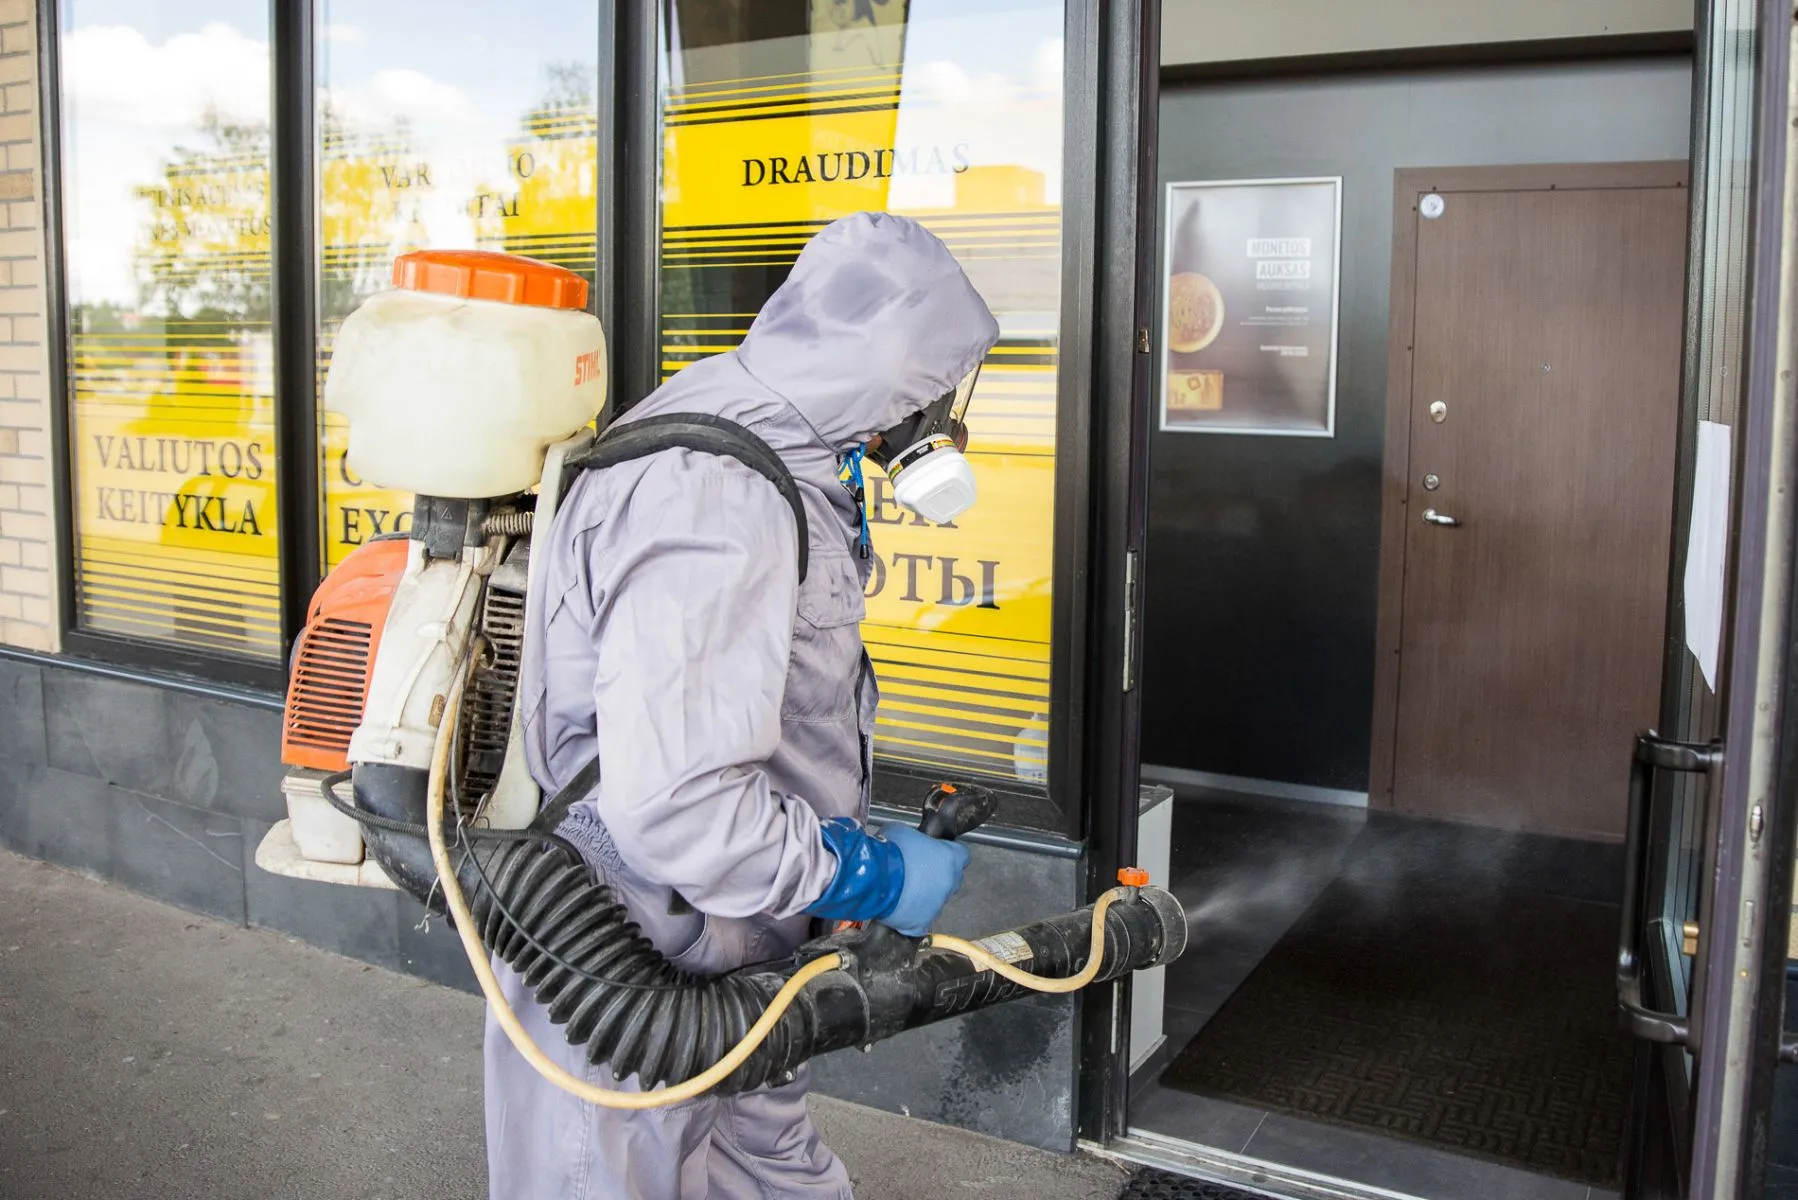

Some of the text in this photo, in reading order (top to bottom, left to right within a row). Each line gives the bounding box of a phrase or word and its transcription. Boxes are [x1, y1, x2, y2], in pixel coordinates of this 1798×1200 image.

[741, 143, 970, 187] DRAUDIMAS
[1251, 240, 1308, 255] MONETOS
[1259, 262, 1307, 277] AUKSAS
[93, 435, 262, 480] VALIUTOS
[96, 487, 262, 535] KEITYKLA
